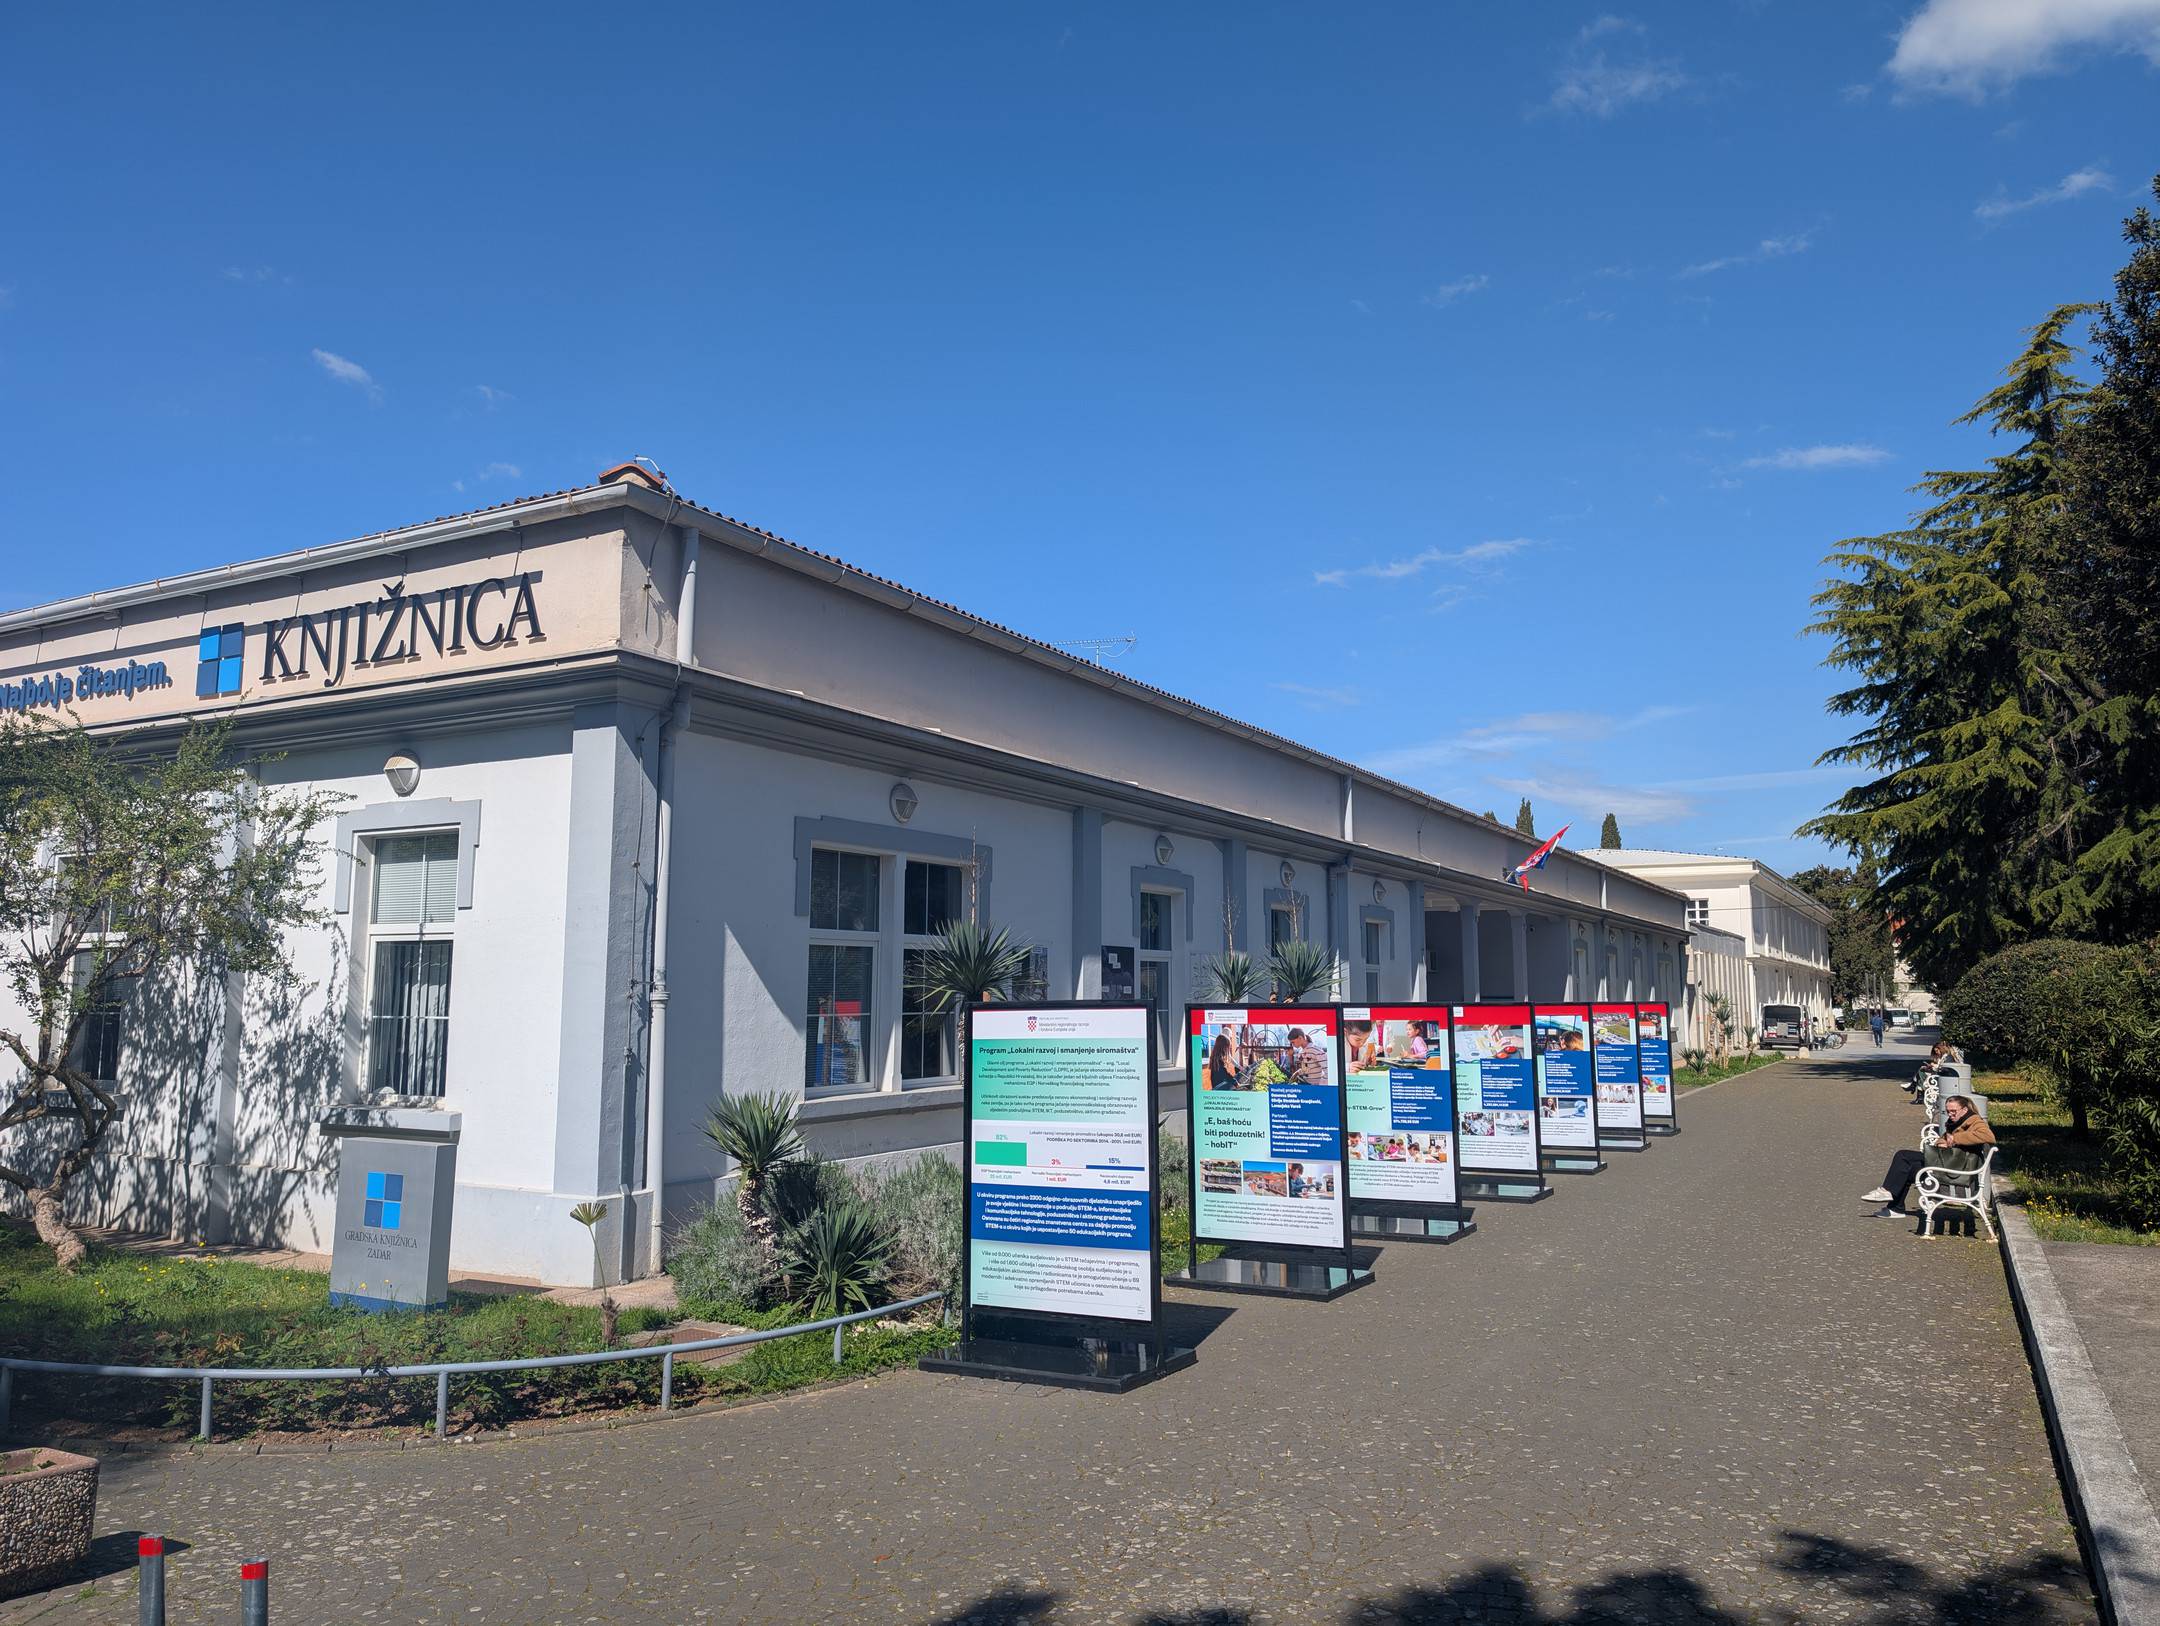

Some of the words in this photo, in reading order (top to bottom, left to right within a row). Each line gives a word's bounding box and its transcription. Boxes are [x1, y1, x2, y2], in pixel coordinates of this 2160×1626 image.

[258, 571, 546, 687] KNJIŽNICA
[76, 659, 172, 700] čitanjem.
[1219, 1130, 1265, 1138] poduzetnik!
[345, 1230, 378, 1244] GRADSKA
[380, 1232, 418, 1248] KNJIŽNICA
[368, 1248, 391, 1260] ZADAR
